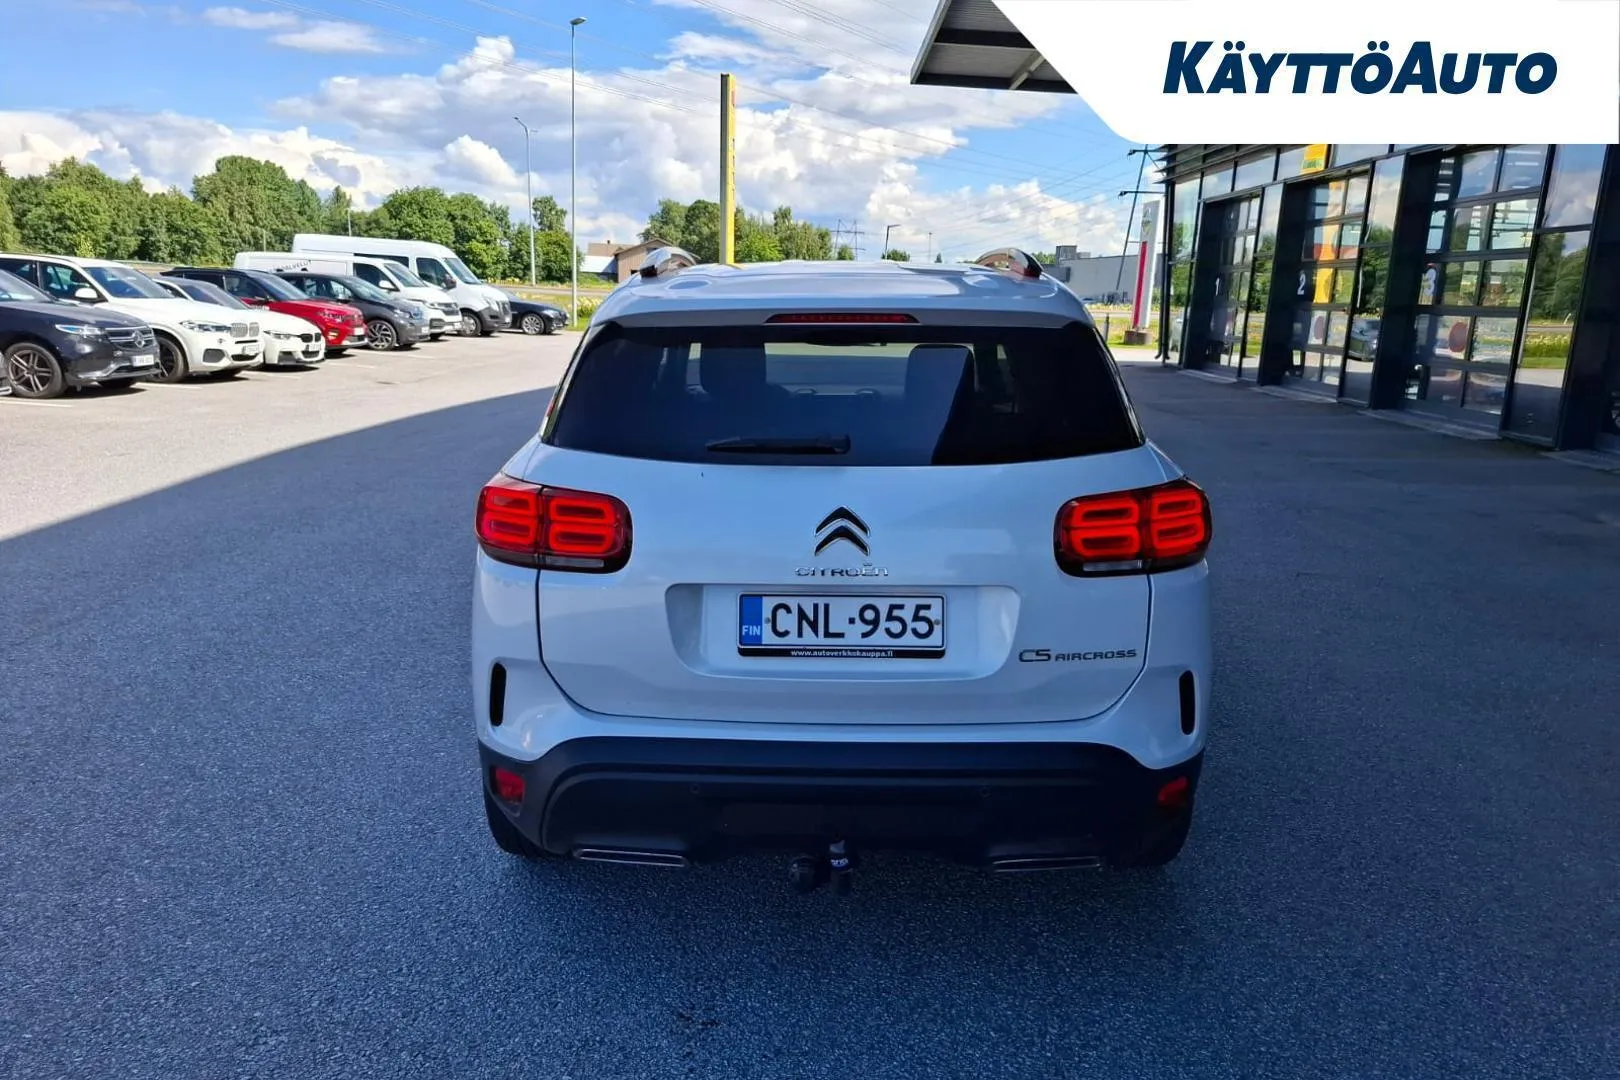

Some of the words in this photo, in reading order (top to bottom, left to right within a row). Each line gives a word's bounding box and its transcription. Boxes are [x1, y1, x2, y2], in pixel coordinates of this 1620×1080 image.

[1215, 277, 1220, 296] 1
[1297, 273, 1306, 295] 2
[1422, 268, 1437, 296] 3
[795, 562, 889, 577] CITROËN
[741, 625, 761, 636] FIN
[1018, 649, 1052, 662] C5
[1055, 649, 1137, 661] AIRCROSS
